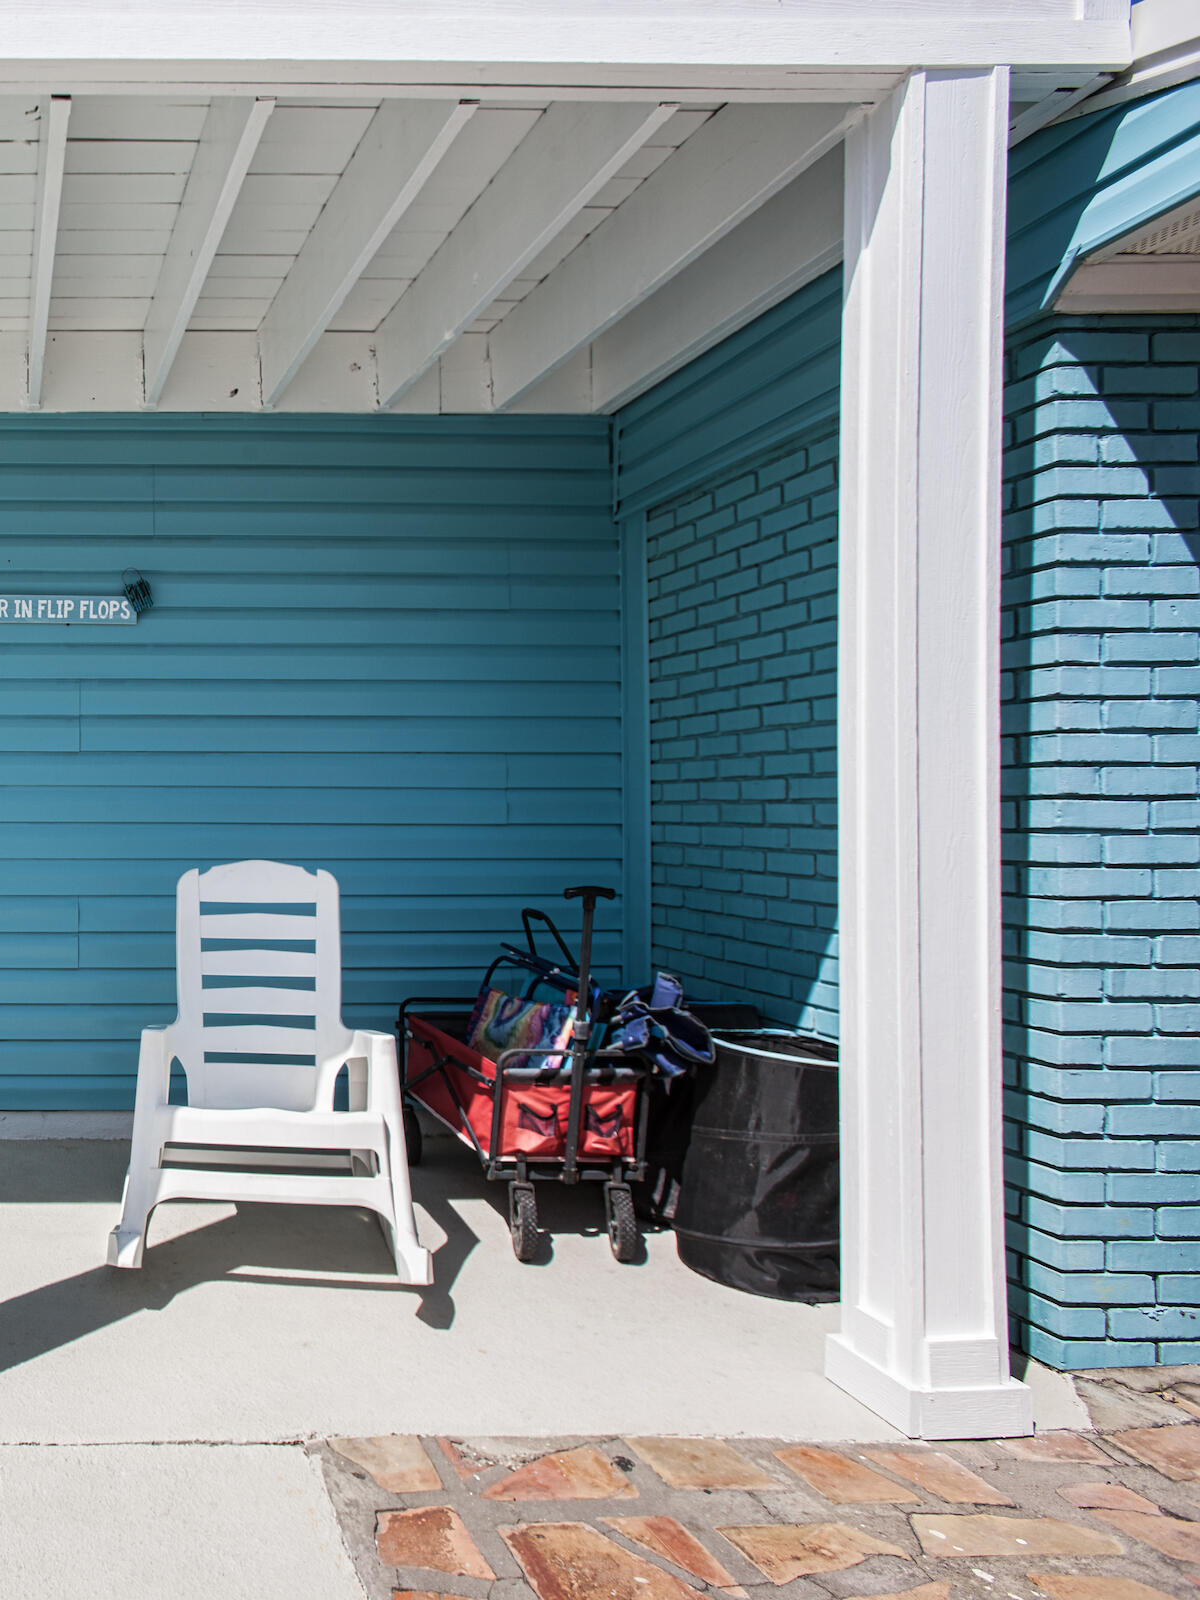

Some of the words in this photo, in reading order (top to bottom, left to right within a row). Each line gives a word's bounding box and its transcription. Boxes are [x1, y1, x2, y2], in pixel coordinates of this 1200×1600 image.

[14, 599, 33, 618] IN
[38, 599, 75, 619] FLIP
[79, 599, 131, 620] FLOPS
